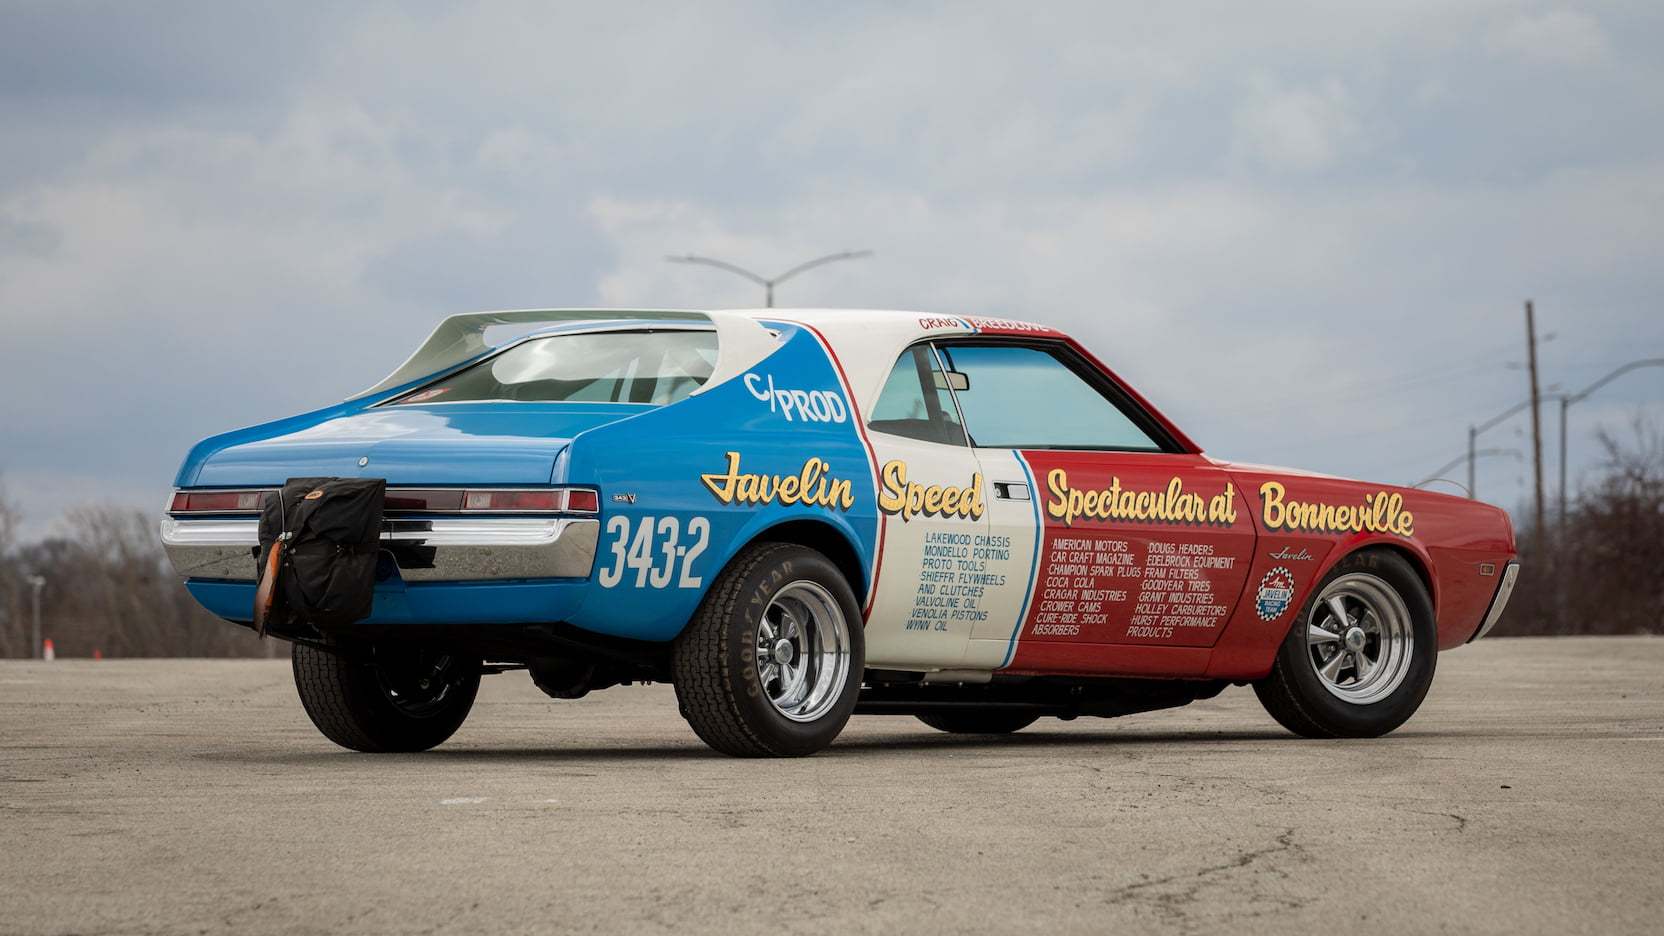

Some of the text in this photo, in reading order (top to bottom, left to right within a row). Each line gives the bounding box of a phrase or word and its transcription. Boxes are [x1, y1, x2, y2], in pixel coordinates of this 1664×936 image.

[918, 318, 1050, 332] CRAIG BREEDLOVE
[743, 373, 846, 424] C/PROD
[700, 451, 1414, 538] Javelin Speed Spectacular at Bonneville
[925, 532, 1011, 548] LAKEWOOD CHASSIS
[1053, 538, 1128, 552] AMERICAN MOTORS
[599, 515, 710, 588] 343-2
[924, 545, 1010, 560] MONDELLO PORTING
[1148, 542, 1214, 555] DOUGS HEADERS
[1268, 546, 1315, 560] Javelin
[1051, 551, 1135, 565] CAR CRAFT MAGAZINE
[1146, 555, 1236, 569] EDELBROCK EQUIPMENT
[922, 558, 985, 572] PROTO TOOLS
[1048, 564, 1141, 577] CHAMPION SPARK PLUGS
[958, 573, 1006, 586] FLYWHEELS
[1144, 567, 1199, 580] FRAM FILTERS
[1046, 577, 1095, 588] COCA COLA
[1142, 580, 1210, 592] GOODYEAR TIRES
[918, 584, 984, 597] AND CLUTCHES
[1044, 589, 1127, 601] CRAGAR INDUSTRIES
[1263, 590, 1288, 599] JAVELIN
[916, 596, 976, 609] VALVOLINE OIL
[1139, 592, 1214, 604] GRANT INDUSTRIES
[1040, 600, 1102, 612] CROWER CAMS
[1135, 604, 1228, 616] HOLLEY CARBURETORS
[912, 608, 988, 620] VENOLIA PISTONS
[1036, 612, 1108, 624] CURE-RIDE SHOCK
[906, 619, 948, 631] WYNN OIL
[1131, 615, 1218, 627] HURST PERFORMANCE
[1032, 624, 1080, 635] ABSORBERS
[1126, 626, 1173, 638] PRODUCTS
